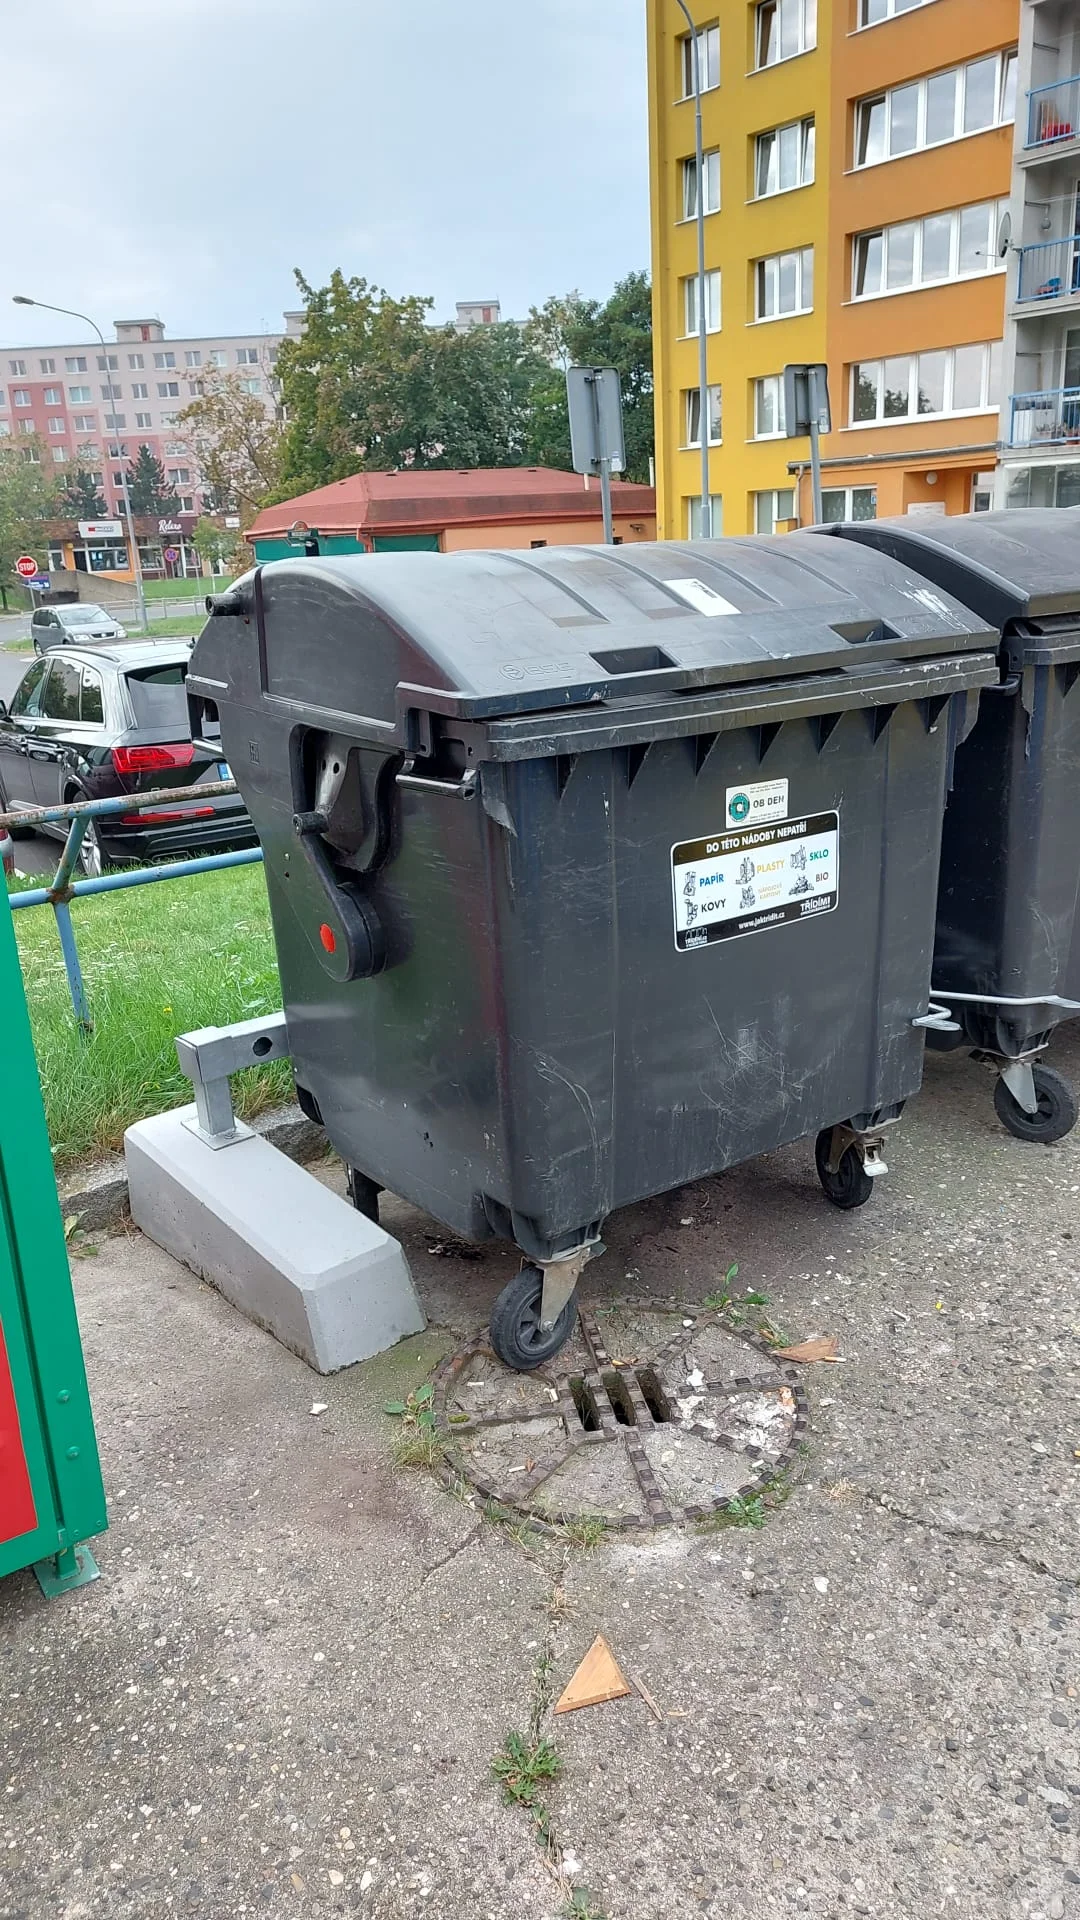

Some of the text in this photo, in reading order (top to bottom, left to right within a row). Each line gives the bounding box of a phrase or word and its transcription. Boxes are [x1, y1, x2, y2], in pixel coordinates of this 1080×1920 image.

[19, 563, 35, 572] STOP
[753, 795, 785, 808] OB DEN
[706, 821, 807, 853] DO TÉTO NÁDOBY NEPATŘÍ
[809, 848, 829, 861] SKLO
[756, 860, 785, 873] PLASTY
[699, 872, 725, 887] PAPÍR
[815, 871, 829, 882] BIO
[701, 898, 726, 912] KOVY
[738, 911, 785, 929] www.jaktridit.cz
